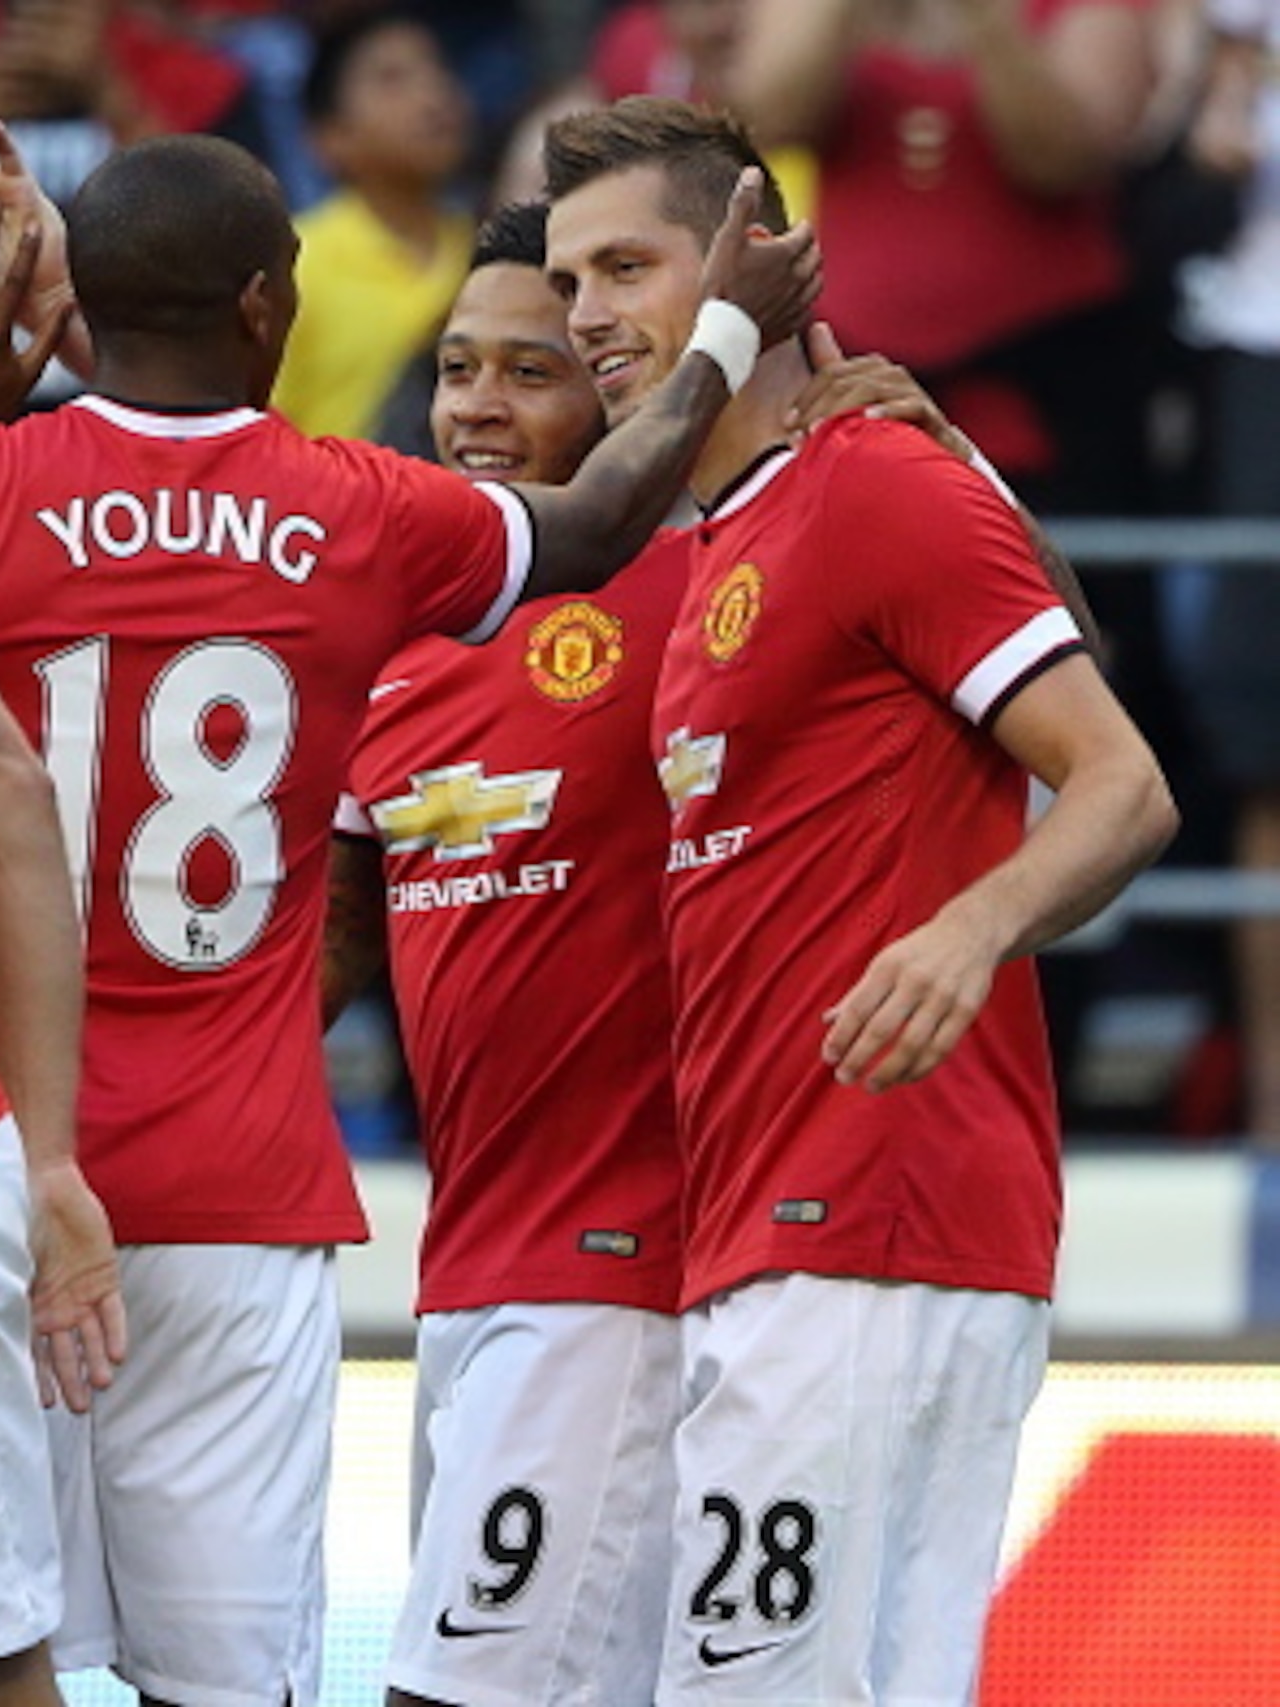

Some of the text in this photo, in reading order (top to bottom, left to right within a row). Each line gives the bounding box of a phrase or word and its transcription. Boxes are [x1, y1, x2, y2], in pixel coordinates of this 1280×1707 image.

[35, 488, 326, 584] YOUNG
[31, 632, 299, 972] 18
[387, 860, 576, 913] CHEVROLET
[470, 1487, 544, 1610] 9
[688, 1494, 816, 1624] 28
